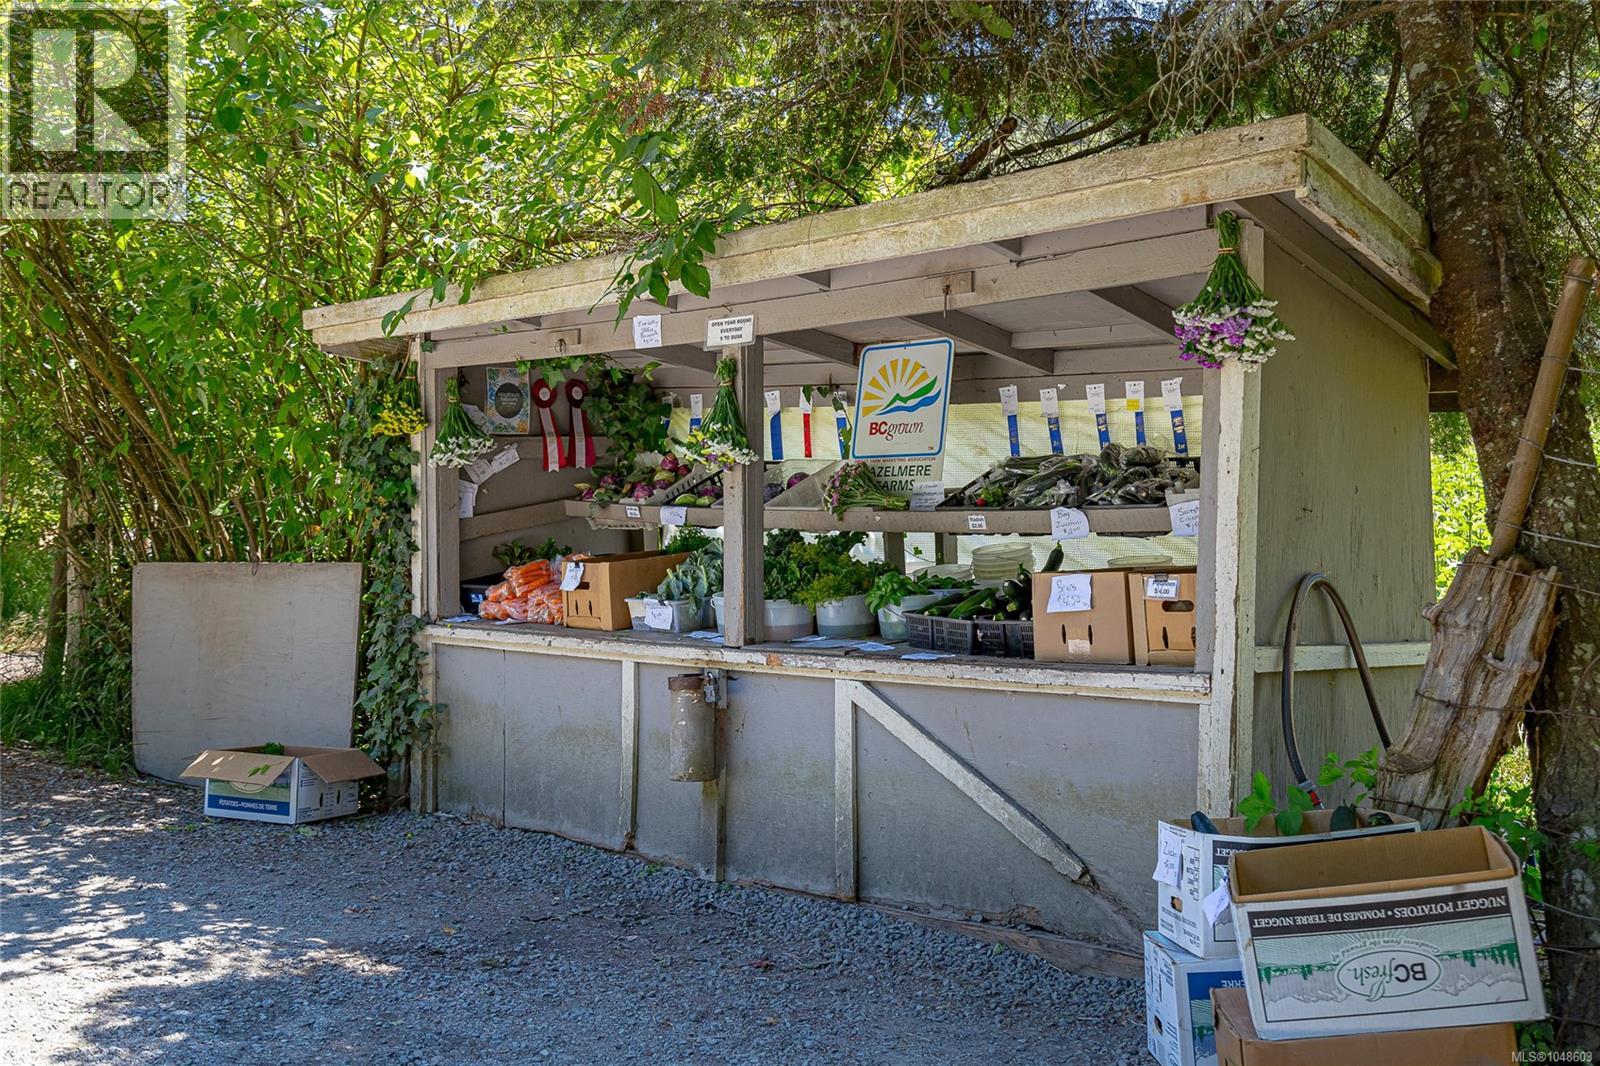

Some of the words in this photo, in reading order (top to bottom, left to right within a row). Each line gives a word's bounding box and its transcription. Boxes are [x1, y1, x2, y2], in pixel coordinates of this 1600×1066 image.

[711, 320, 724, 328] OPEN
[724, 318, 736, 326] YEAR
[720, 326, 743, 334] EVERYDAY
[870, 464, 932, 477] AZELMERE
[1455, 895, 1508, 912] NUGGET
[1342, 909, 1386, 921] POMMES
[1394, 902, 1454, 918] POTATOES
[1252, 917, 1295, 928] NUGGET
[1295, 914, 1327, 925] TERRE
[1327, 912, 1341, 922] DE
[1221, 980, 1247, 988] ERRE
